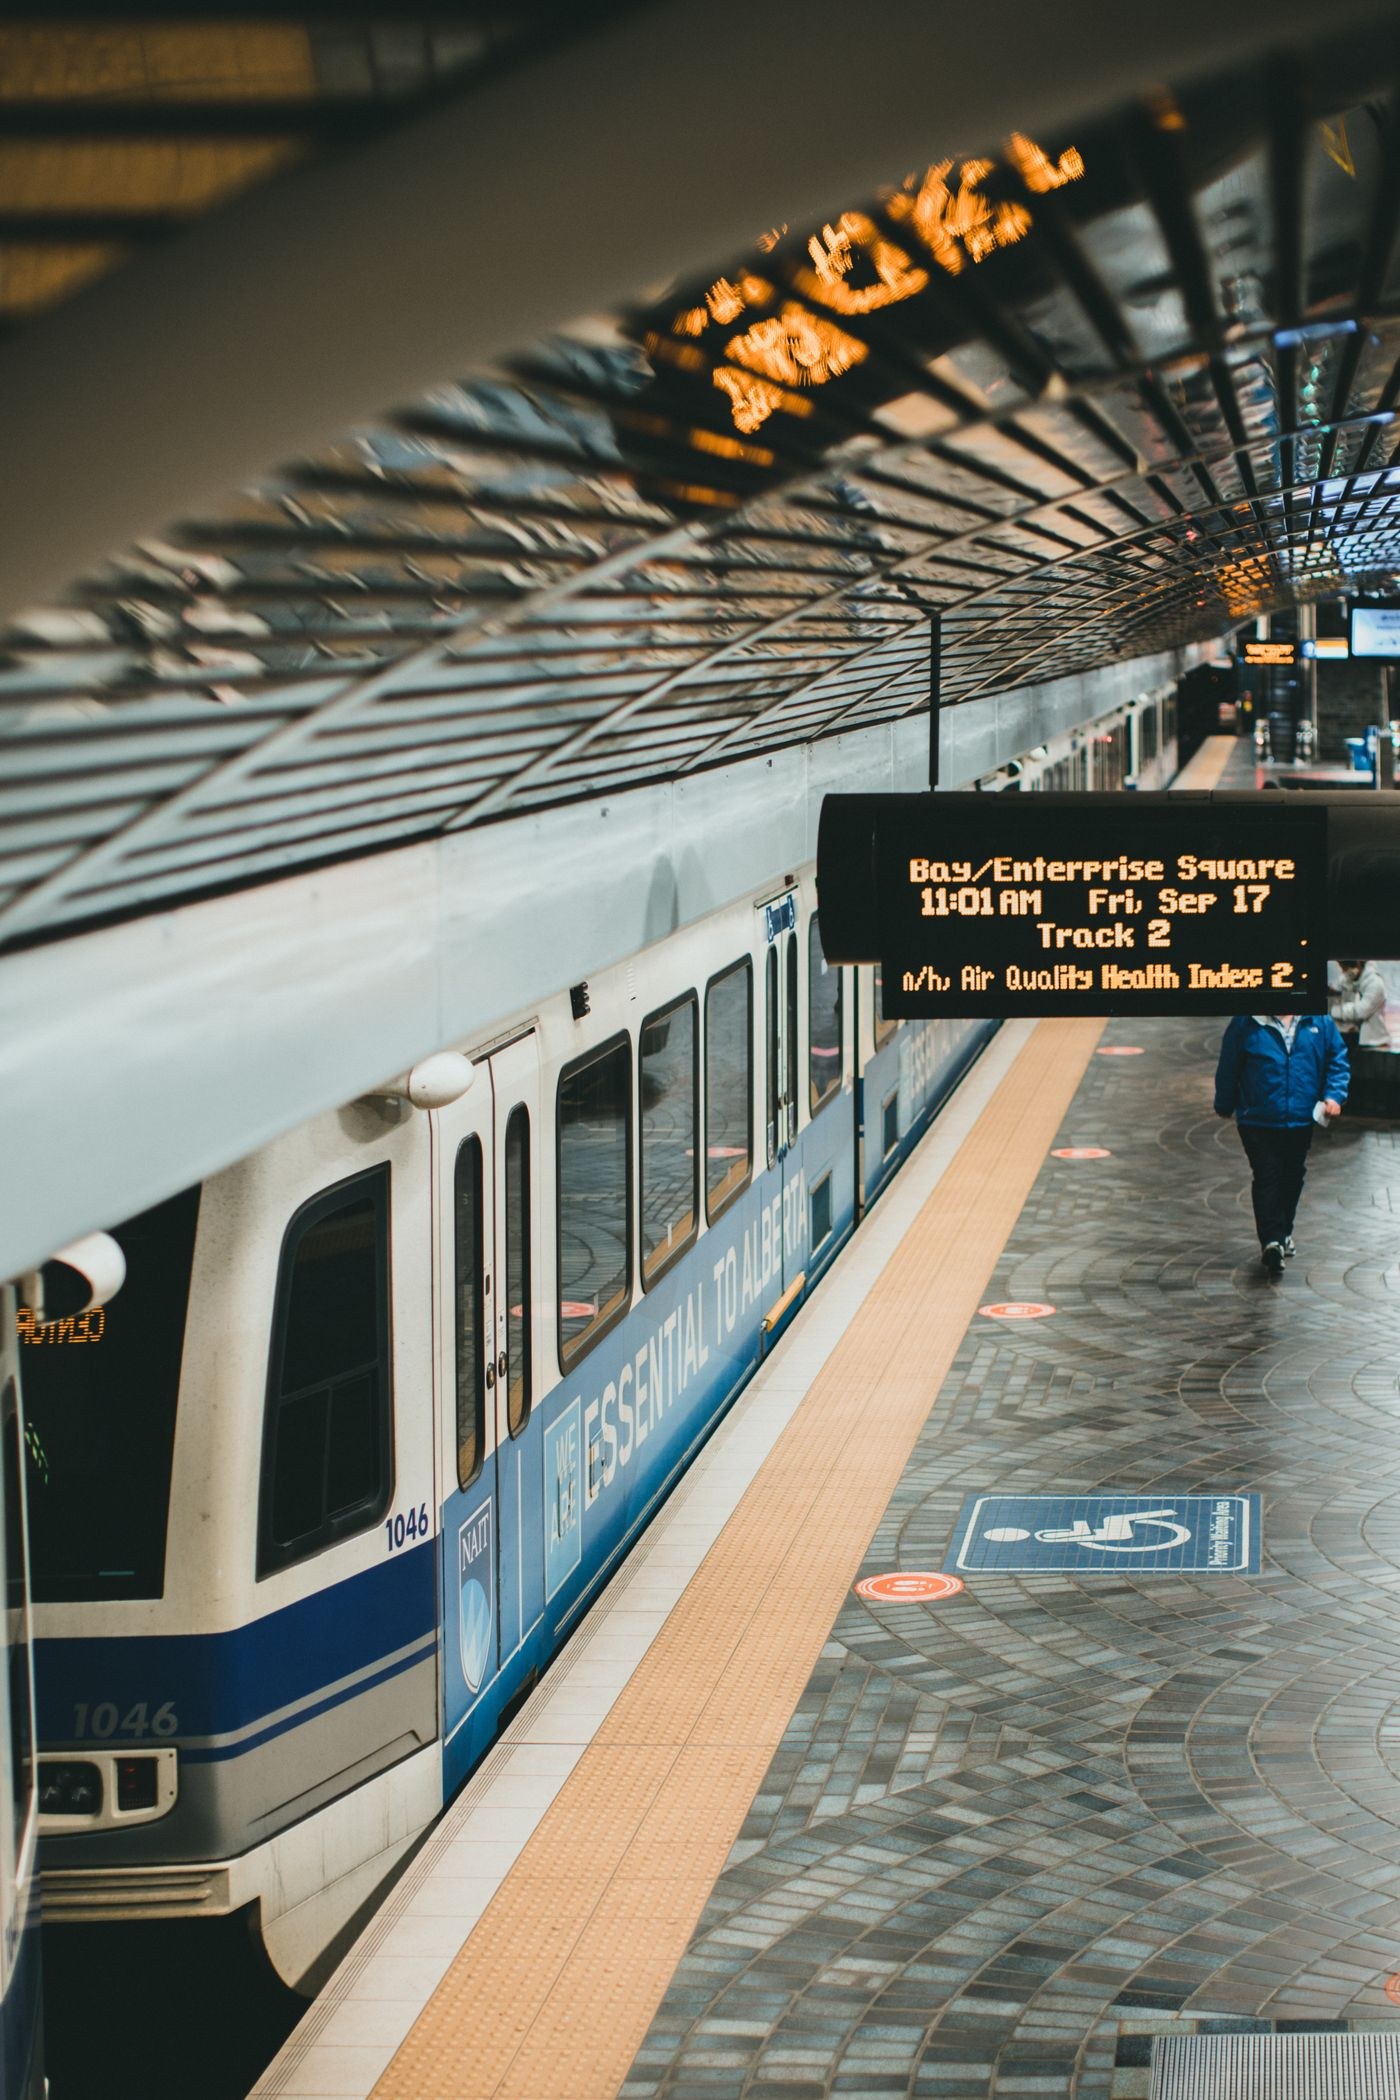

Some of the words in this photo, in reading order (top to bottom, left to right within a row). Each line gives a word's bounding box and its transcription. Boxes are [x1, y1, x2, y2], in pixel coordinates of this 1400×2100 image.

[909, 855, 1165, 882] Bay/Enterprise
[1177, 854, 1295, 881] Square
[921, 887, 994, 916] 11:01
[999, 889, 1042, 916] AM
[1088, 888, 1143, 915] Fri,
[1158, 888, 1218, 914] Sep
[1233, 884, 1271, 914] 17
[1036, 922, 1135, 948] Track
[1147, 918, 1172, 948] 2
[961, 965, 995, 991] Air
[1005, 964, 1094, 991] Quality
[1101, 963, 1181, 990] Health
[1271, 962, 1294, 989] 2
[584, 1282, 709, 1512] ESSENTIAL
[713, 1245, 738, 1345] TO
[740, 1167, 809, 1316] ALBERTA
[555, 1421, 577, 1486] WE
[385, 1502, 429, 1552] 1046
[462, 1512, 489, 1572] NAIT
[73, 1700, 179, 1739] 1046
